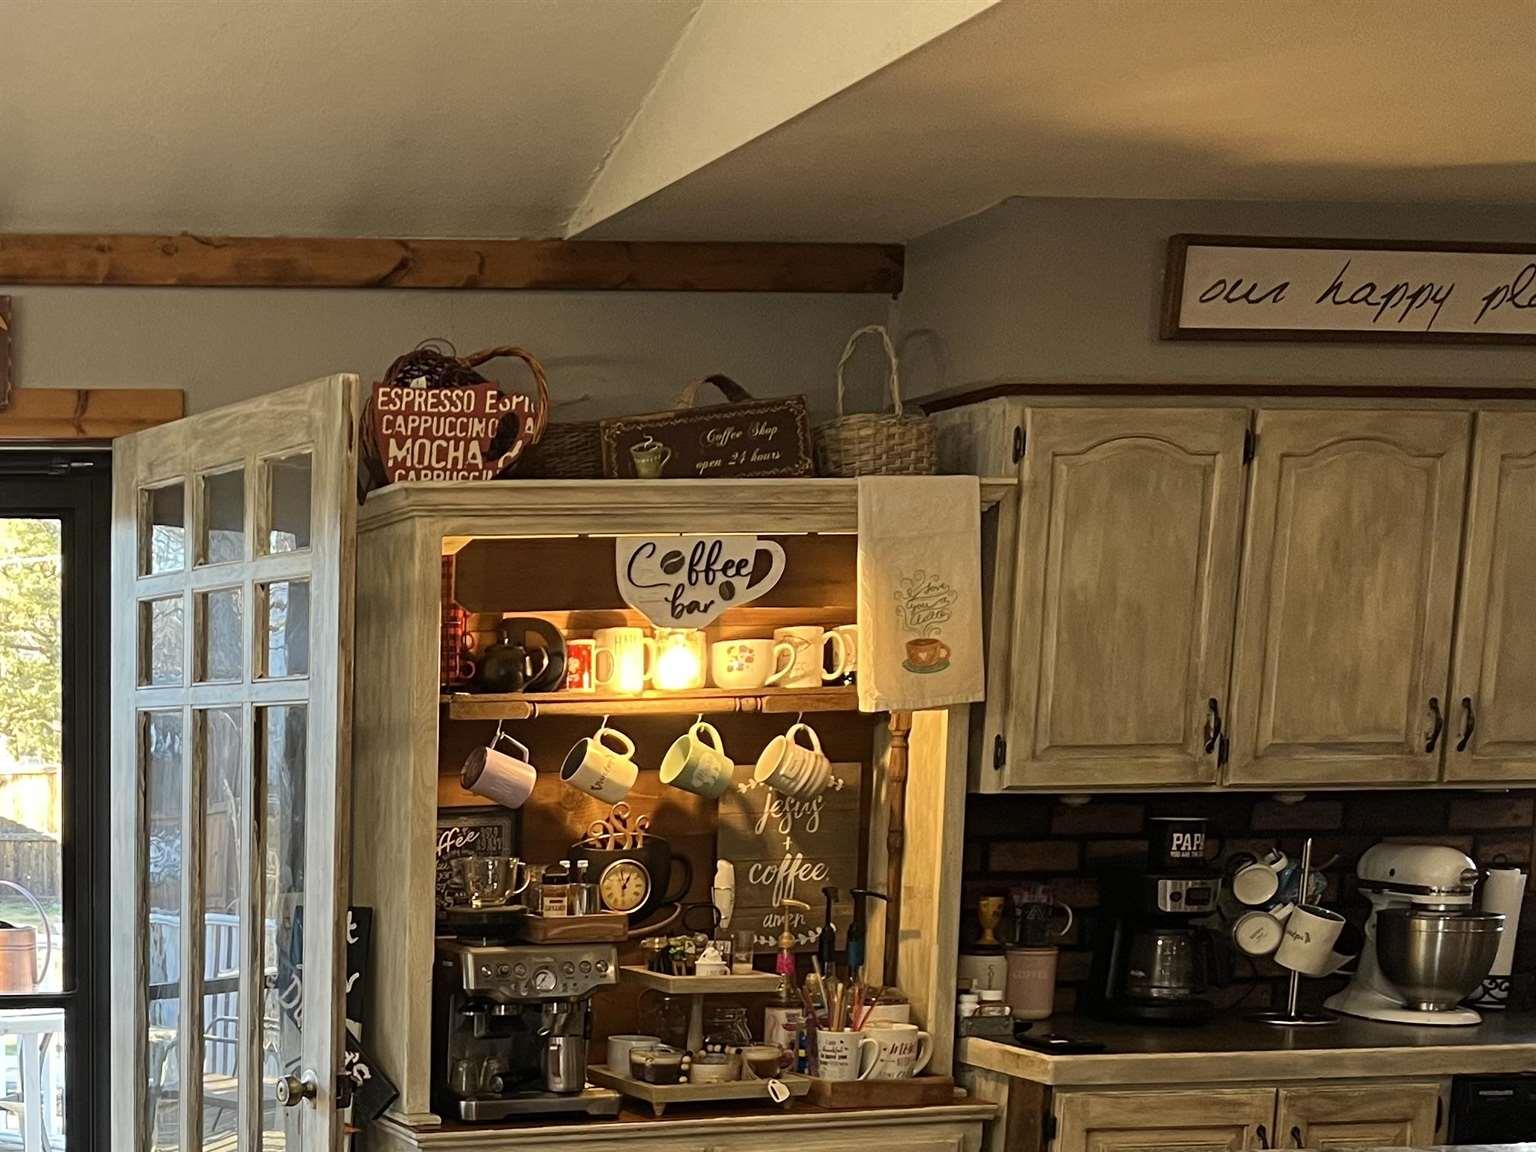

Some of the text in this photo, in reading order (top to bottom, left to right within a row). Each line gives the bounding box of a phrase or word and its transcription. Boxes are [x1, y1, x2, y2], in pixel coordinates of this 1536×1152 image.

[1199, 277, 1291, 306] our
[1315, 257, 1456, 332] happy
[377, 387, 476, 413] ESPRESSO
[381, 414, 499, 438] CAPPUCCINO
[704, 421, 779, 447] Coffee Shop
[387, 438, 484, 470] MOCHA
[695, 458, 722, 476] open
[749, 448, 782, 463] hours
[663, 583, 715, 619] bar
[754, 785, 825, 835] jesus
[748, 852, 830, 907] coffee
